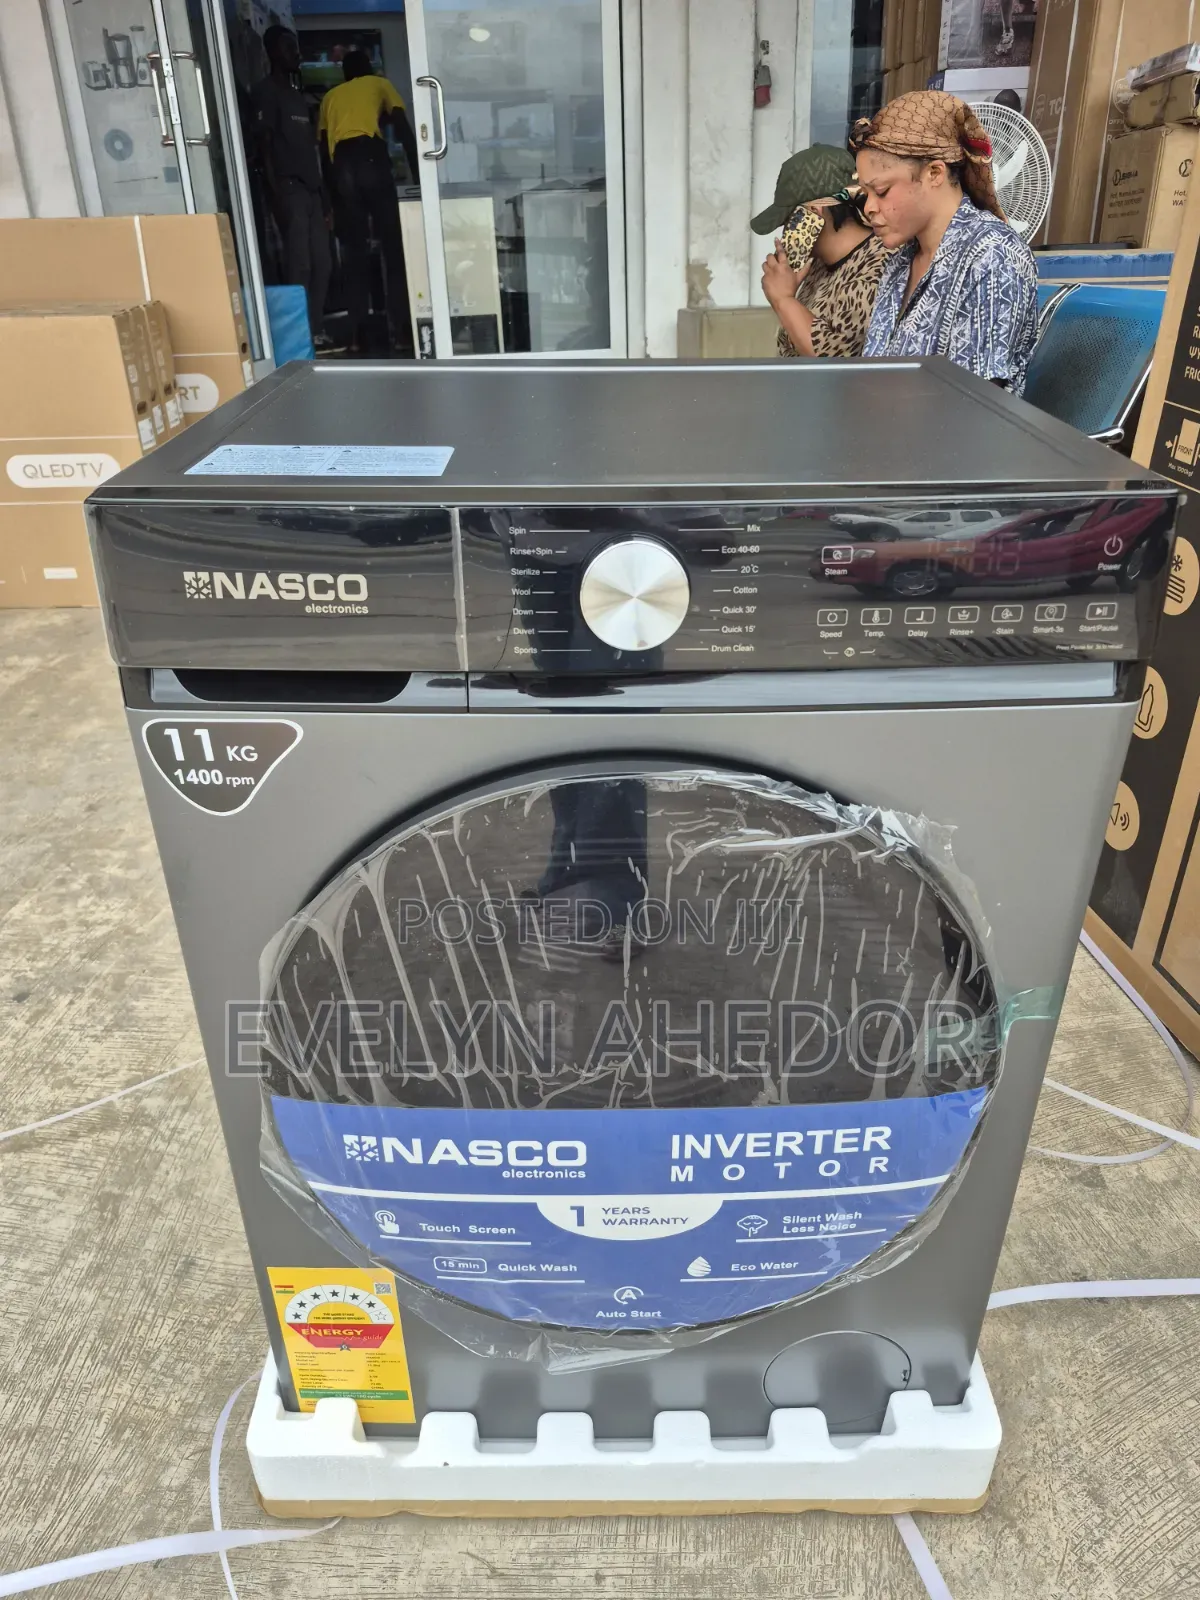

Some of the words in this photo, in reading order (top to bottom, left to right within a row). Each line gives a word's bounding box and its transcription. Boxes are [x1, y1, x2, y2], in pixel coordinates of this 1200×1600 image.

[1049, 97, 1067, 116] TC
[1178, 444, 1193, 456] FRONT
[22, 463, 75, 480] QLED
[76, 462, 104, 478] TV
[508, 526, 526, 536] Spin
[746, 524, 761, 532] Mix
[509, 547, 553, 557] Rinse+Spin
[721, 545, 736, 554] Eco
[738, 545, 760, 553] 40-60
[1097, 562, 1122, 571] Power
[510, 567, 541, 576] Sterilize
[824, 567, 848, 576] Steam
[212, 571, 369, 602] NASCO
[732, 586, 758, 594] Cotton
[511, 588, 531, 596] Wool
[304, 603, 369, 614] electronics
[512, 608, 534, 616] Down
[722, 606, 744, 614] Quick
[513, 627, 535, 635] Duvet
[721, 626, 742, 634] Quick
[819, 630, 843, 639] Speed
[864, 629, 886, 638] Temp.
[907, 629, 928, 638] Delay
[949, 628, 974, 636] Rinse+
[513, 646, 538, 655] Sports
[711, 645, 731, 653] Drum
[733, 644, 754, 652] Clean
[163, 728, 215, 762] 11
[226, 745, 258, 762] KG
[173, 768, 224, 785] 1400
[226, 774, 255, 788] rpm
[671, 1125, 892, 1160] INVERTER
[381, 1136, 588, 1167] NASCO
[501, 1168, 587, 1179] electronics
[670, 1156, 890, 1182] MOTOR
[601, 1206, 651, 1215] YEARS
[570, 1205, 585, 1227] 1
[782, 1214, 822, 1224] Silent
[825, 1211, 863, 1222] Wash
[601, 1216, 689, 1226] WARRANTY
[419, 1222, 461, 1234] Touch
[468, 1225, 516, 1235] Screen
[782, 1225, 815, 1234] Less
[440, 1259, 455, 1268] 15
[457, 1260, 480, 1270] min
[498, 1262, 536, 1273] Quick
[540, 1263, 577, 1272] Wash
[730, 1262, 756, 1272] Eco
[760, 1260, 799, 1271] Water
[595, 1310, 626, 1318] Auto
[630, 1309, 662, 1318] Start
[301, 1326, 364, 1337] ENERGY
[362, 1334, 383, 1342] guide
